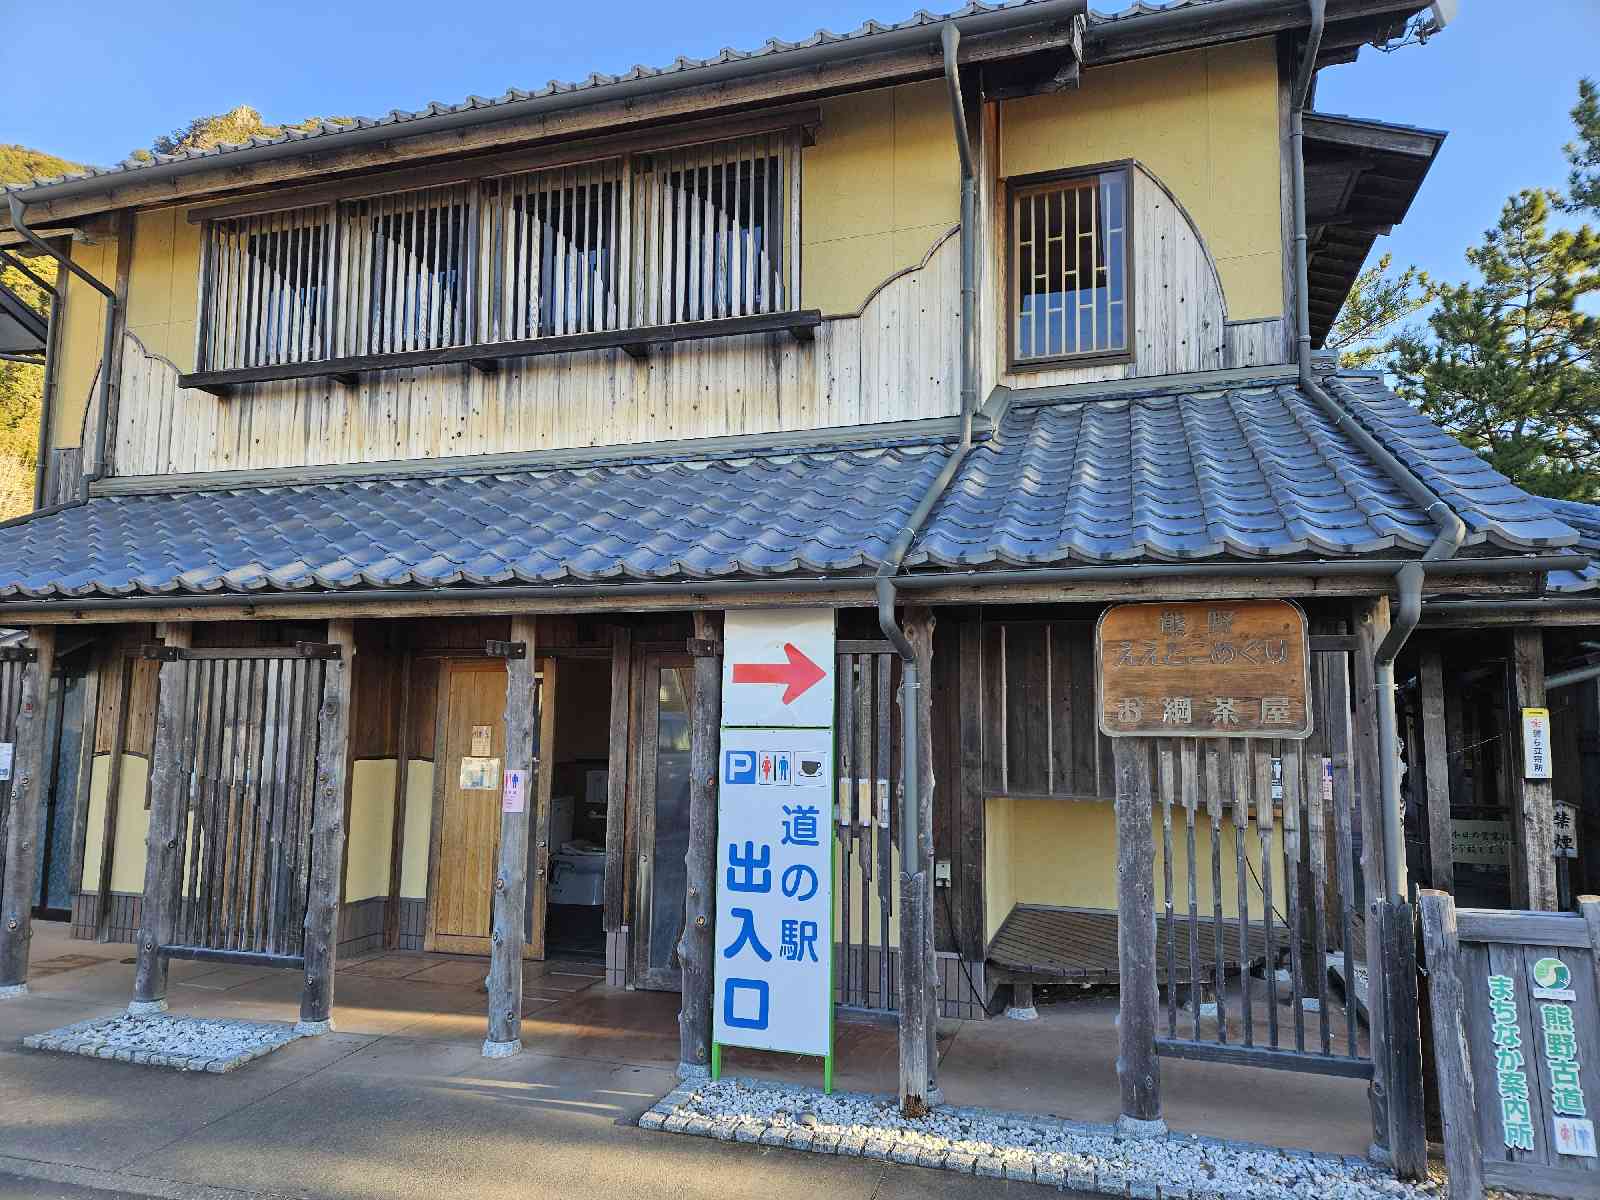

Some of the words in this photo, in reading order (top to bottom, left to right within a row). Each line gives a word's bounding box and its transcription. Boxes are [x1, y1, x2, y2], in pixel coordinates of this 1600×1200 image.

[1117, 697, 1291, 725] お綱茶屋
[779, 804, 821, 963] 道の駅
[1553, 810, 1573, 850] 禁煙
[723, 841, 773, 1030] 出入口
[1488, 976, 1534, 1149] まちなか案内所
[1541, 1004, 1585, 1115] 熊野古道
